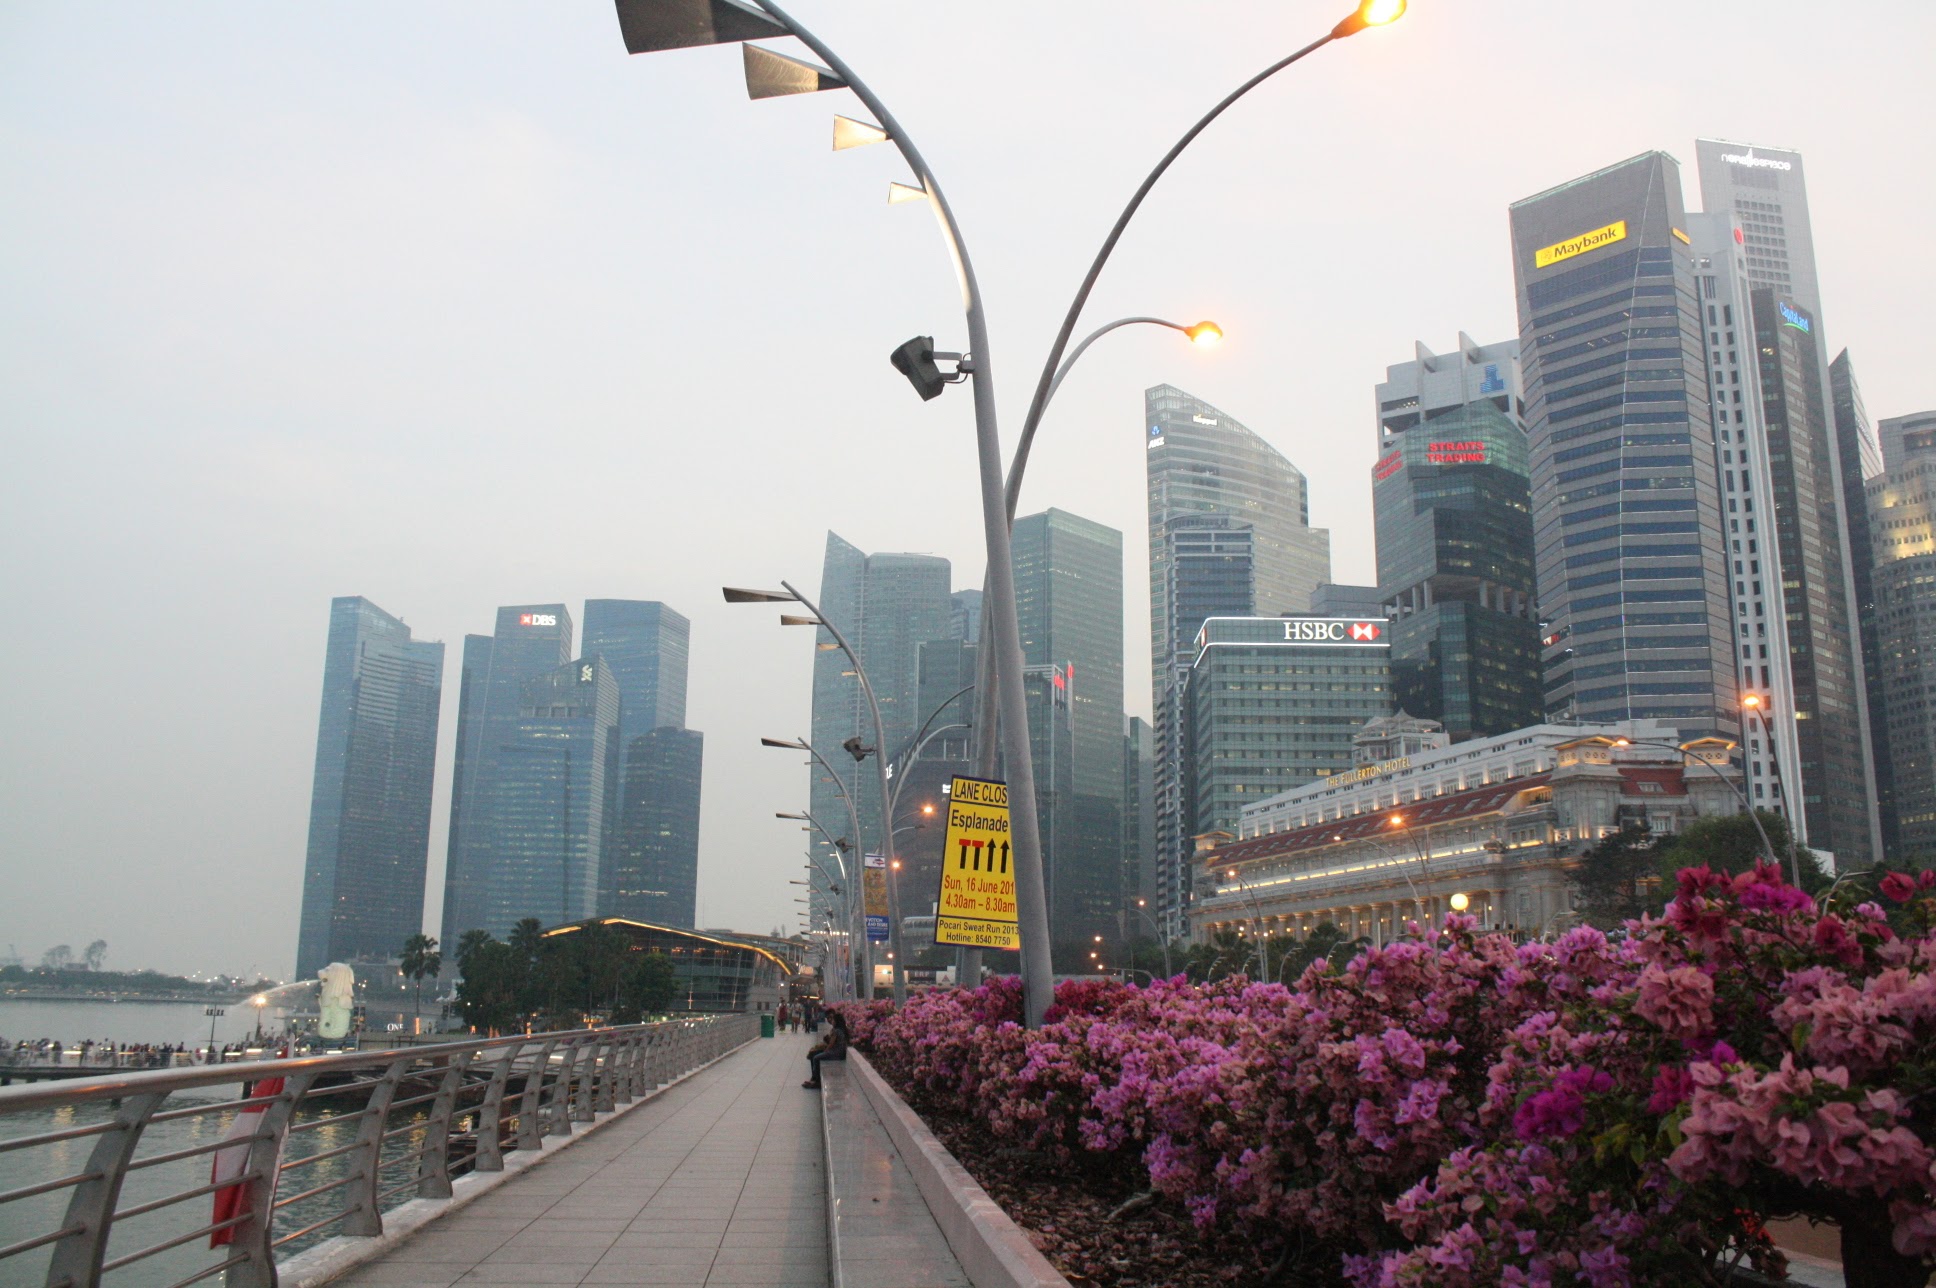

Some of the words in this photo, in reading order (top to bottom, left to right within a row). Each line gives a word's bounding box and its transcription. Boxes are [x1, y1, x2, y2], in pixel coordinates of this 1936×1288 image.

[1554, 227, 1617, 258] Maybank
[1428, 441, 1485, 452] STRAITS
[1426, 453, 1485, 463] TRADING
[532, 614, 556, 626] DBS
[1283, 622, 1344, 640] HSBC
[1326, 777, 1339, 788] THE
[1341, 765, 1382, 785] FULLERTON
[1384, 757, 1411, 772] HOTEL
[954, 781, 980, 800] LANE
[982, 784, 1008, 804] CLOS
[951, 809, 1008, 832] Esplanade
[944, 875, 963, 893] Sun,
[966, 877, 976, 892] 16
[978, 879, 998, 894] June
[1000, 881, 1015, 895] 201
[945, 893, 976, 910] 4.30am
[985, 896, 1016, 913] 8.30am
[938, 919, 962, 931] Pocari
[963, 922, 985, 933] Sweat
[986, 923, 1001, 934] Run
[1002, 925, 1019, 935] 2013
[946, 931, 974, 943] Hotline:
[975, 934, 992, 945] 8540
[993, 935, 1011, 946] 7750
